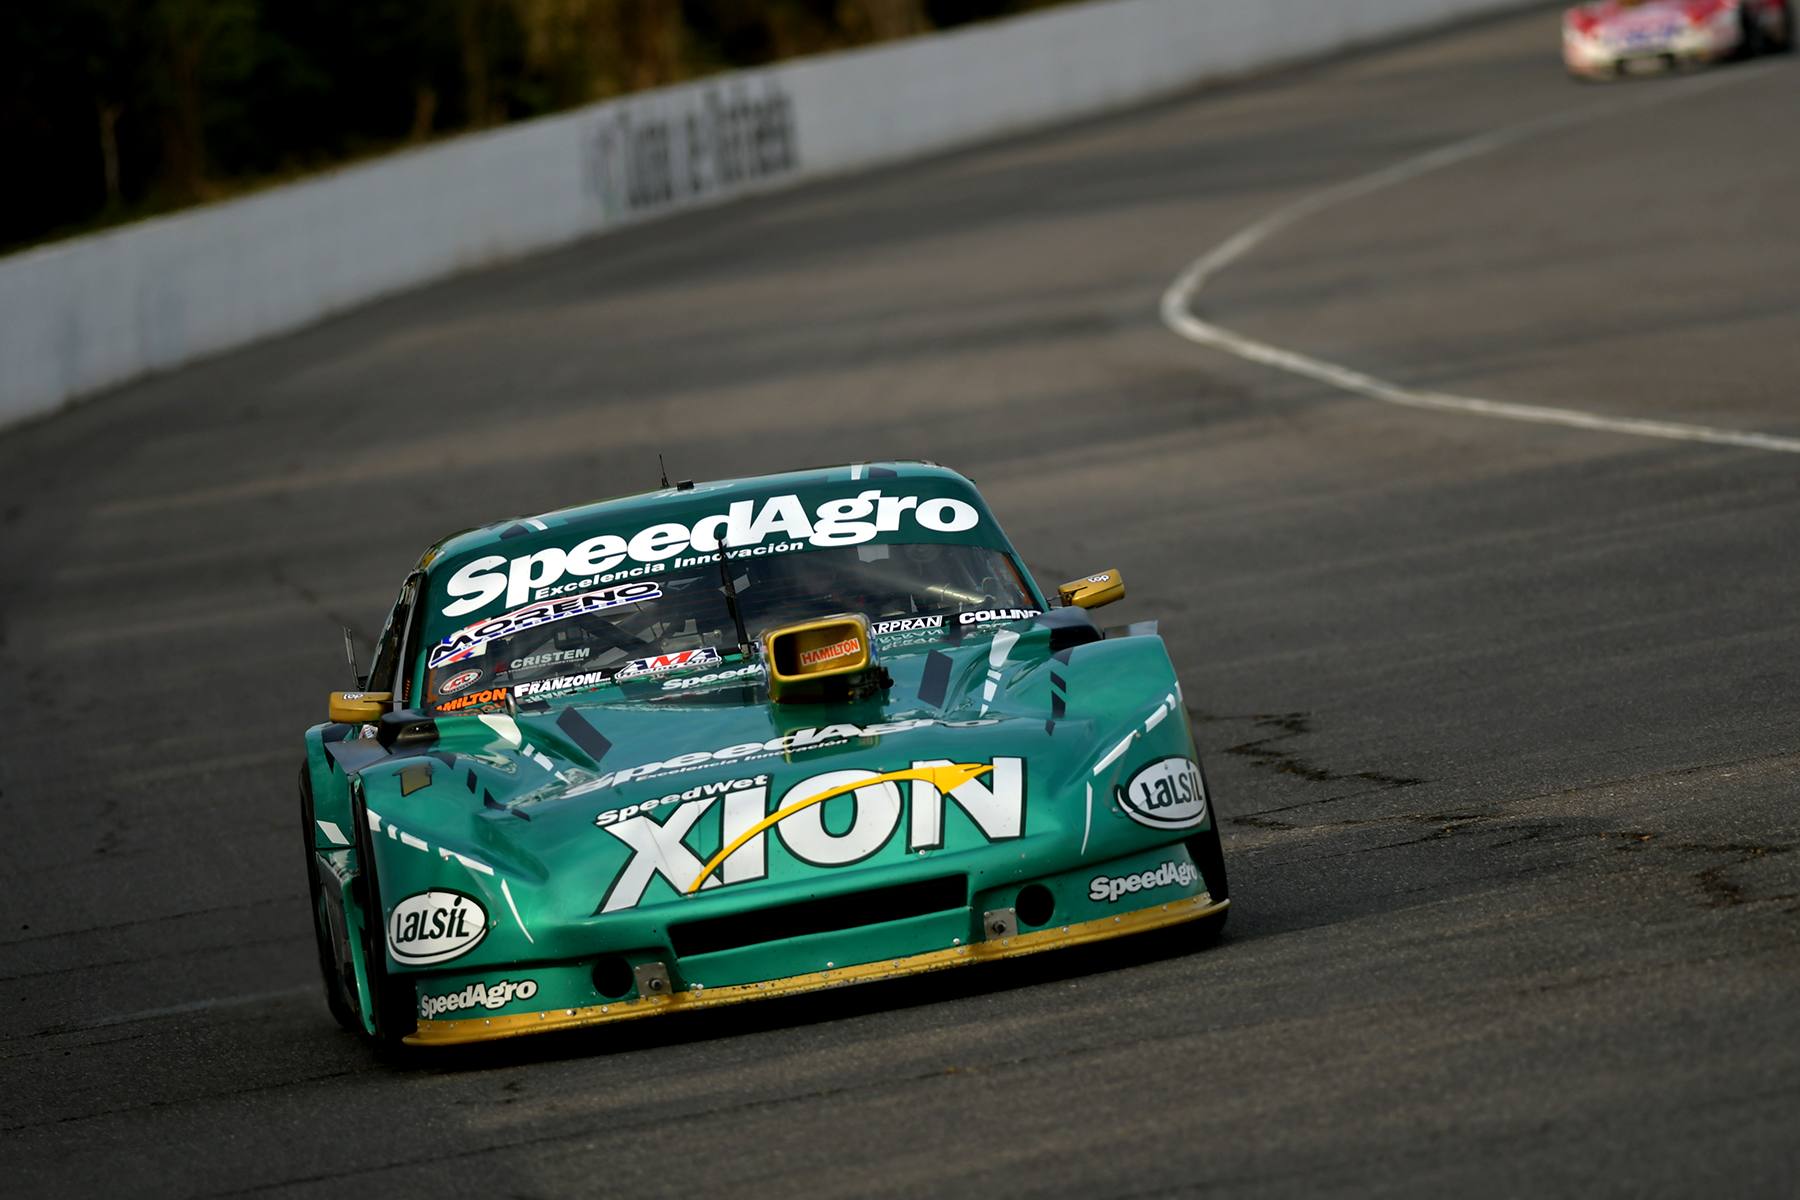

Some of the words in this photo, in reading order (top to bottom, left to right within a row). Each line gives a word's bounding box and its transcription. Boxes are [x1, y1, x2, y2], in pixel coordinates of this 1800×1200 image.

[442, 490, 979, 617] SpeedAgro
[535, 562, 665, 600] Excelencia
[674, 541, 804, 569] Innovación
[431, 584, 659, 660] MORENO
[511, 648, 590, 669] CRISTEM
[801, 638, 859, 665] HAMILTON
[560, 719, 1000, 800] SpeedAgro
[635, 758, 738, 782] Excelencia
[596, 774, 769, 826] SpeedWet
[596, 757, 1025, 916] XION
[1089, 862, 1198, 902] SpeedAgro
[420, 980, 538, 1019] SpeedAgro
